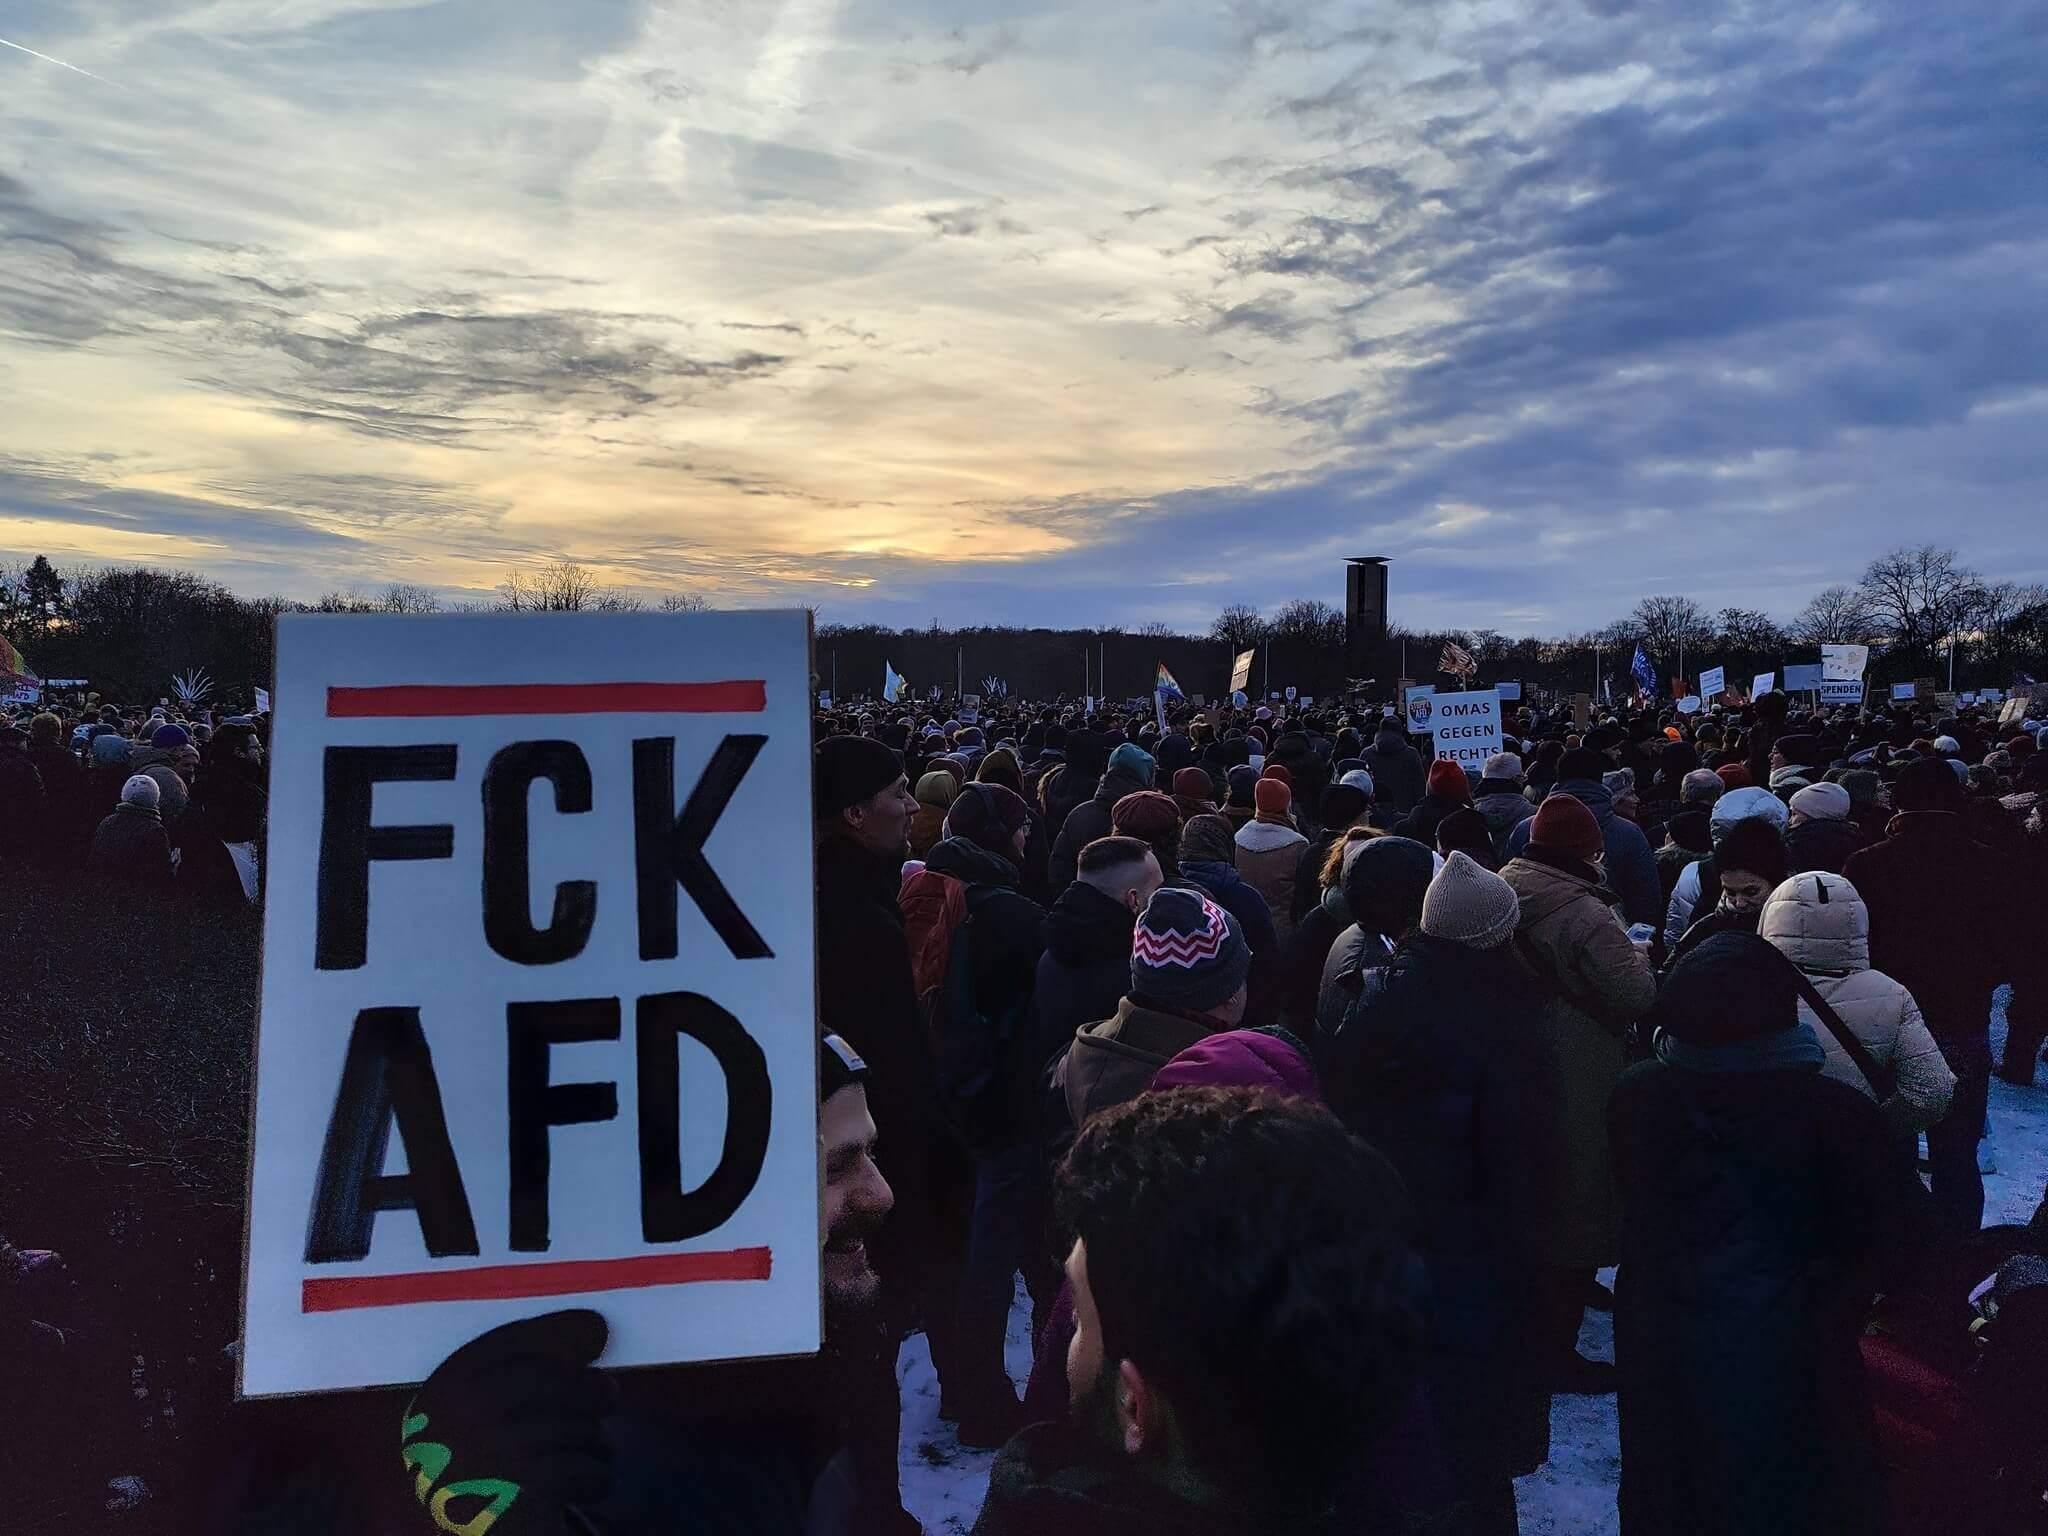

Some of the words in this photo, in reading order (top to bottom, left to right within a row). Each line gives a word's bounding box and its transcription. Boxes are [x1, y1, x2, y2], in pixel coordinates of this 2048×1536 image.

[1821, 685, 1861, 694] SPENDEN
[1441, 702, 1491, 717] OMAS
[1440, 724, 1494, 739] GEGEN
[1438, 746, 1500, 761] RECHTS
[315, 733, 775, 970] FCK
[304, 991, 773, 1264] AFD
